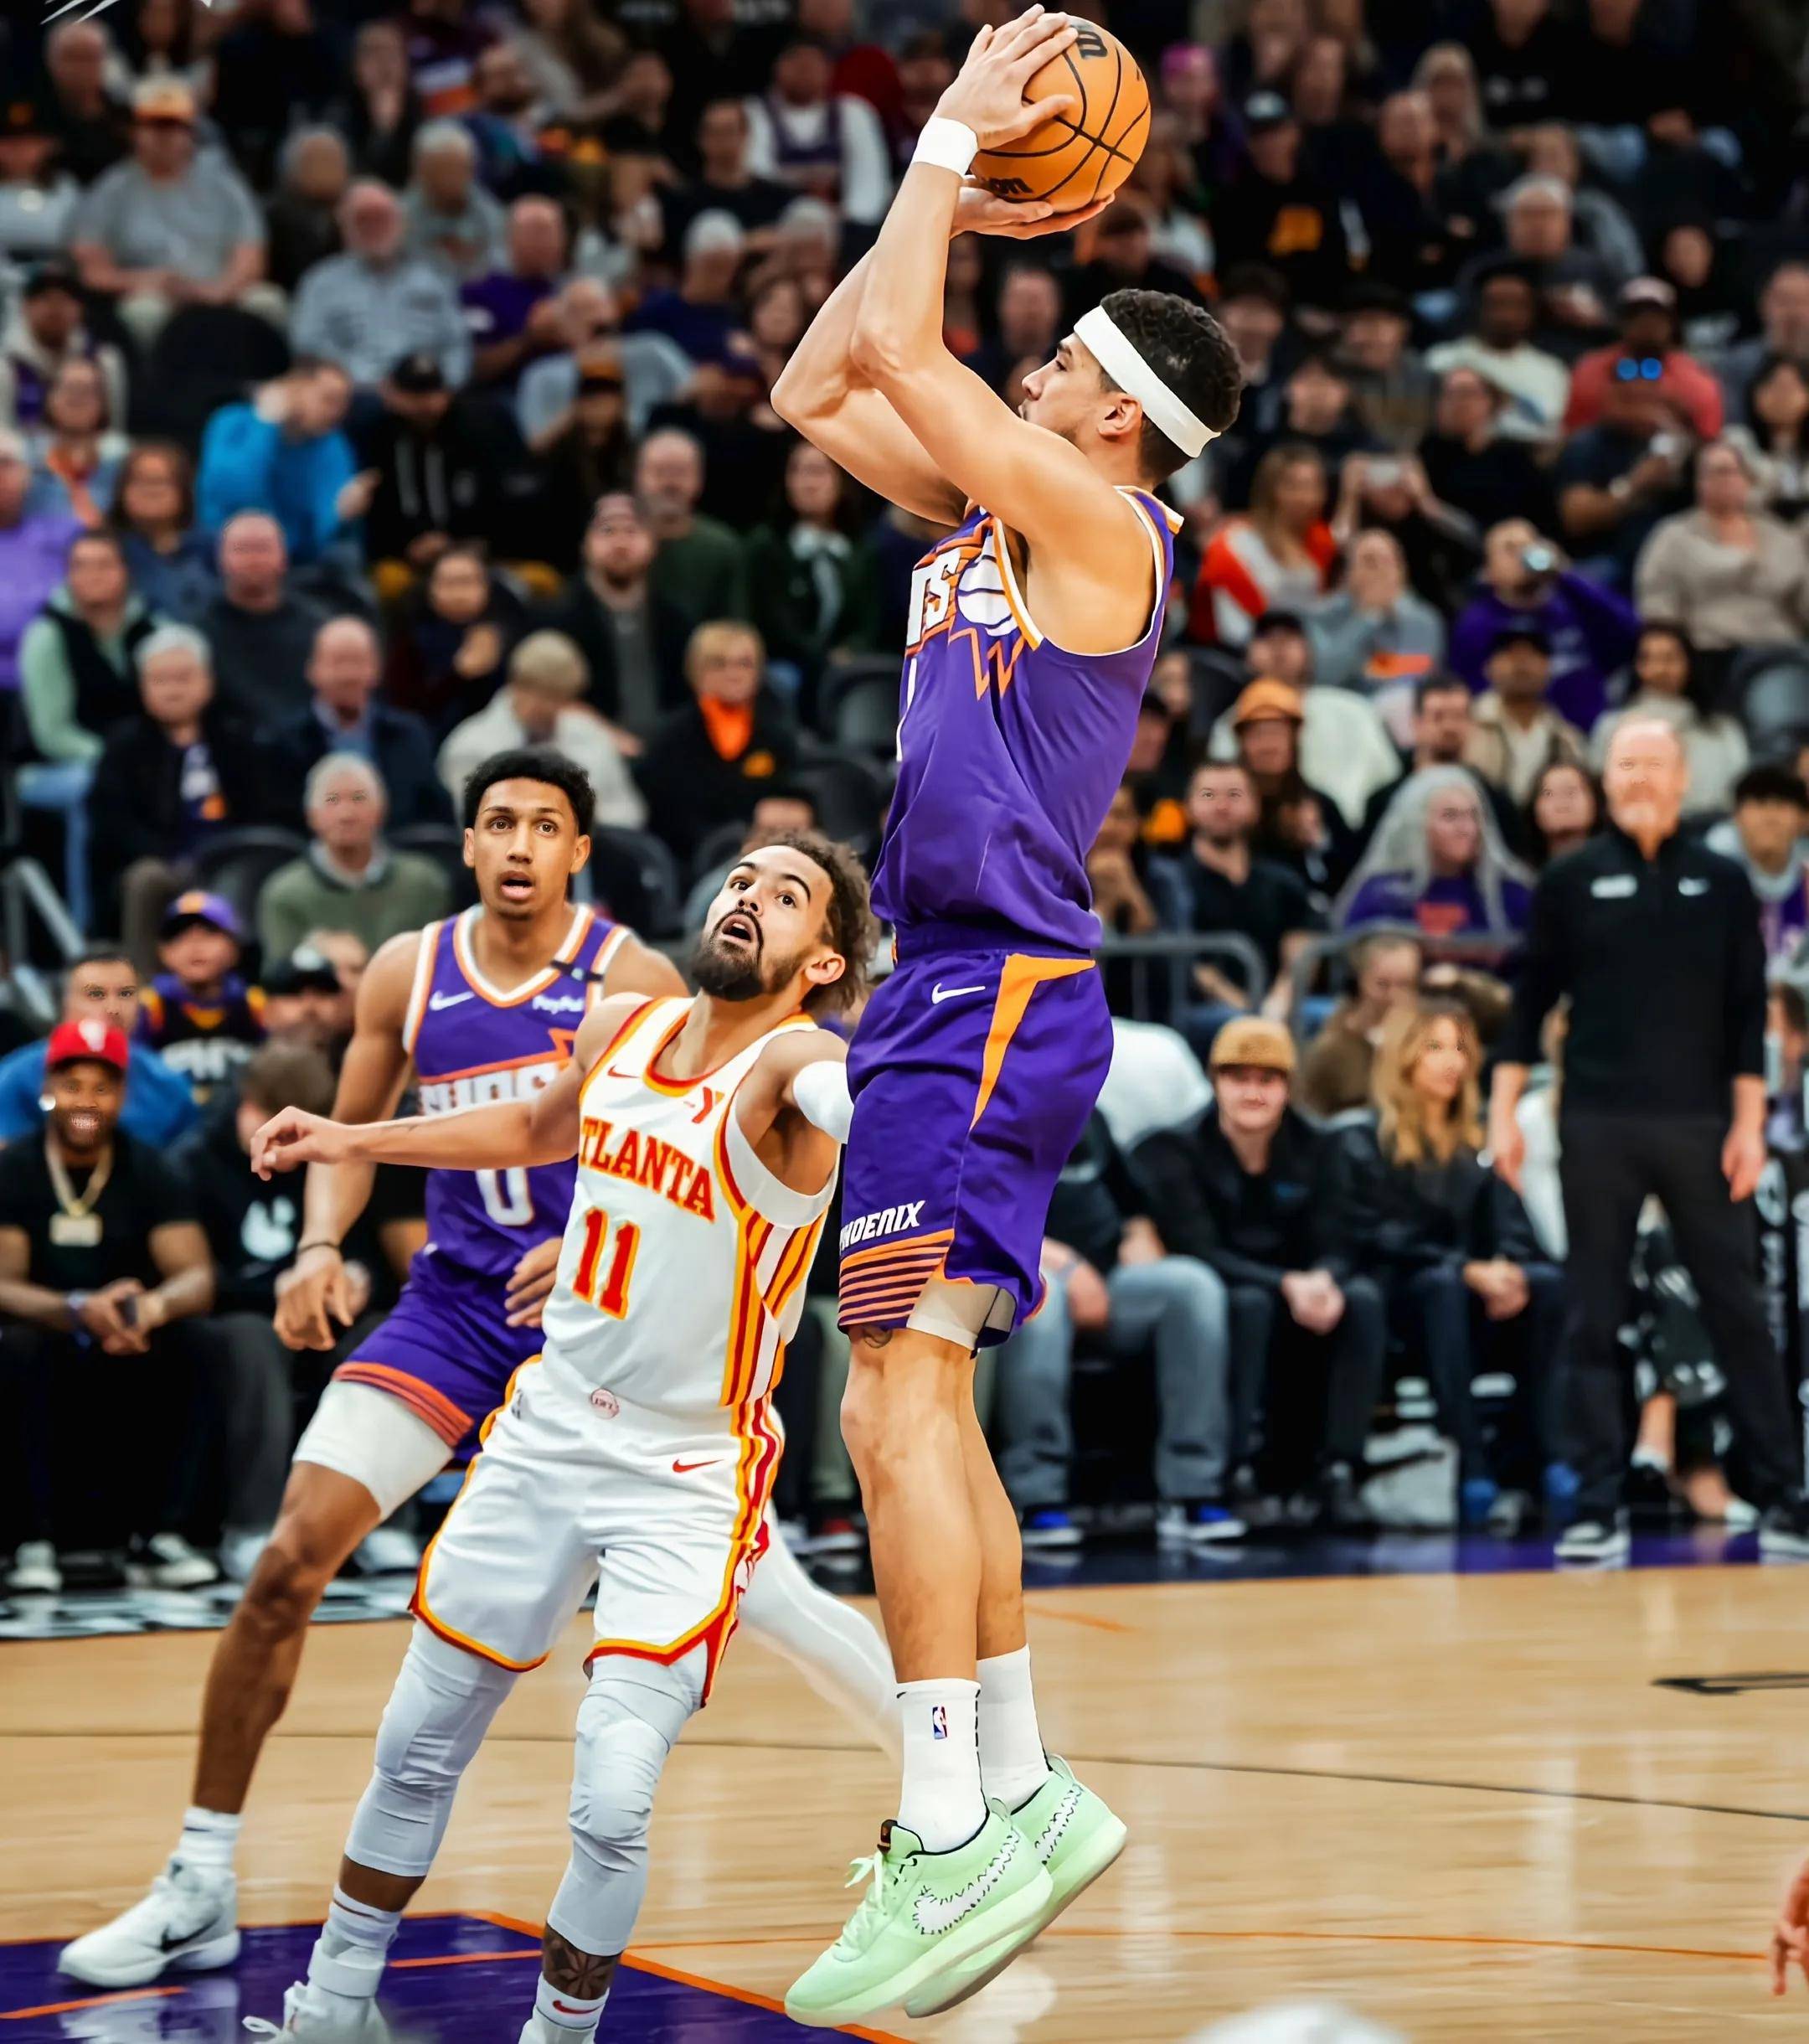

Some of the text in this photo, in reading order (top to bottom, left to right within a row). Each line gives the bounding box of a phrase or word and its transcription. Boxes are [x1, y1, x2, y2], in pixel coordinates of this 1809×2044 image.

[578, 1115, 715, 1224] TLANTA
[572, 1205, 641, 1321] 11
[839, 1200, 926, 1256] HOENIX
